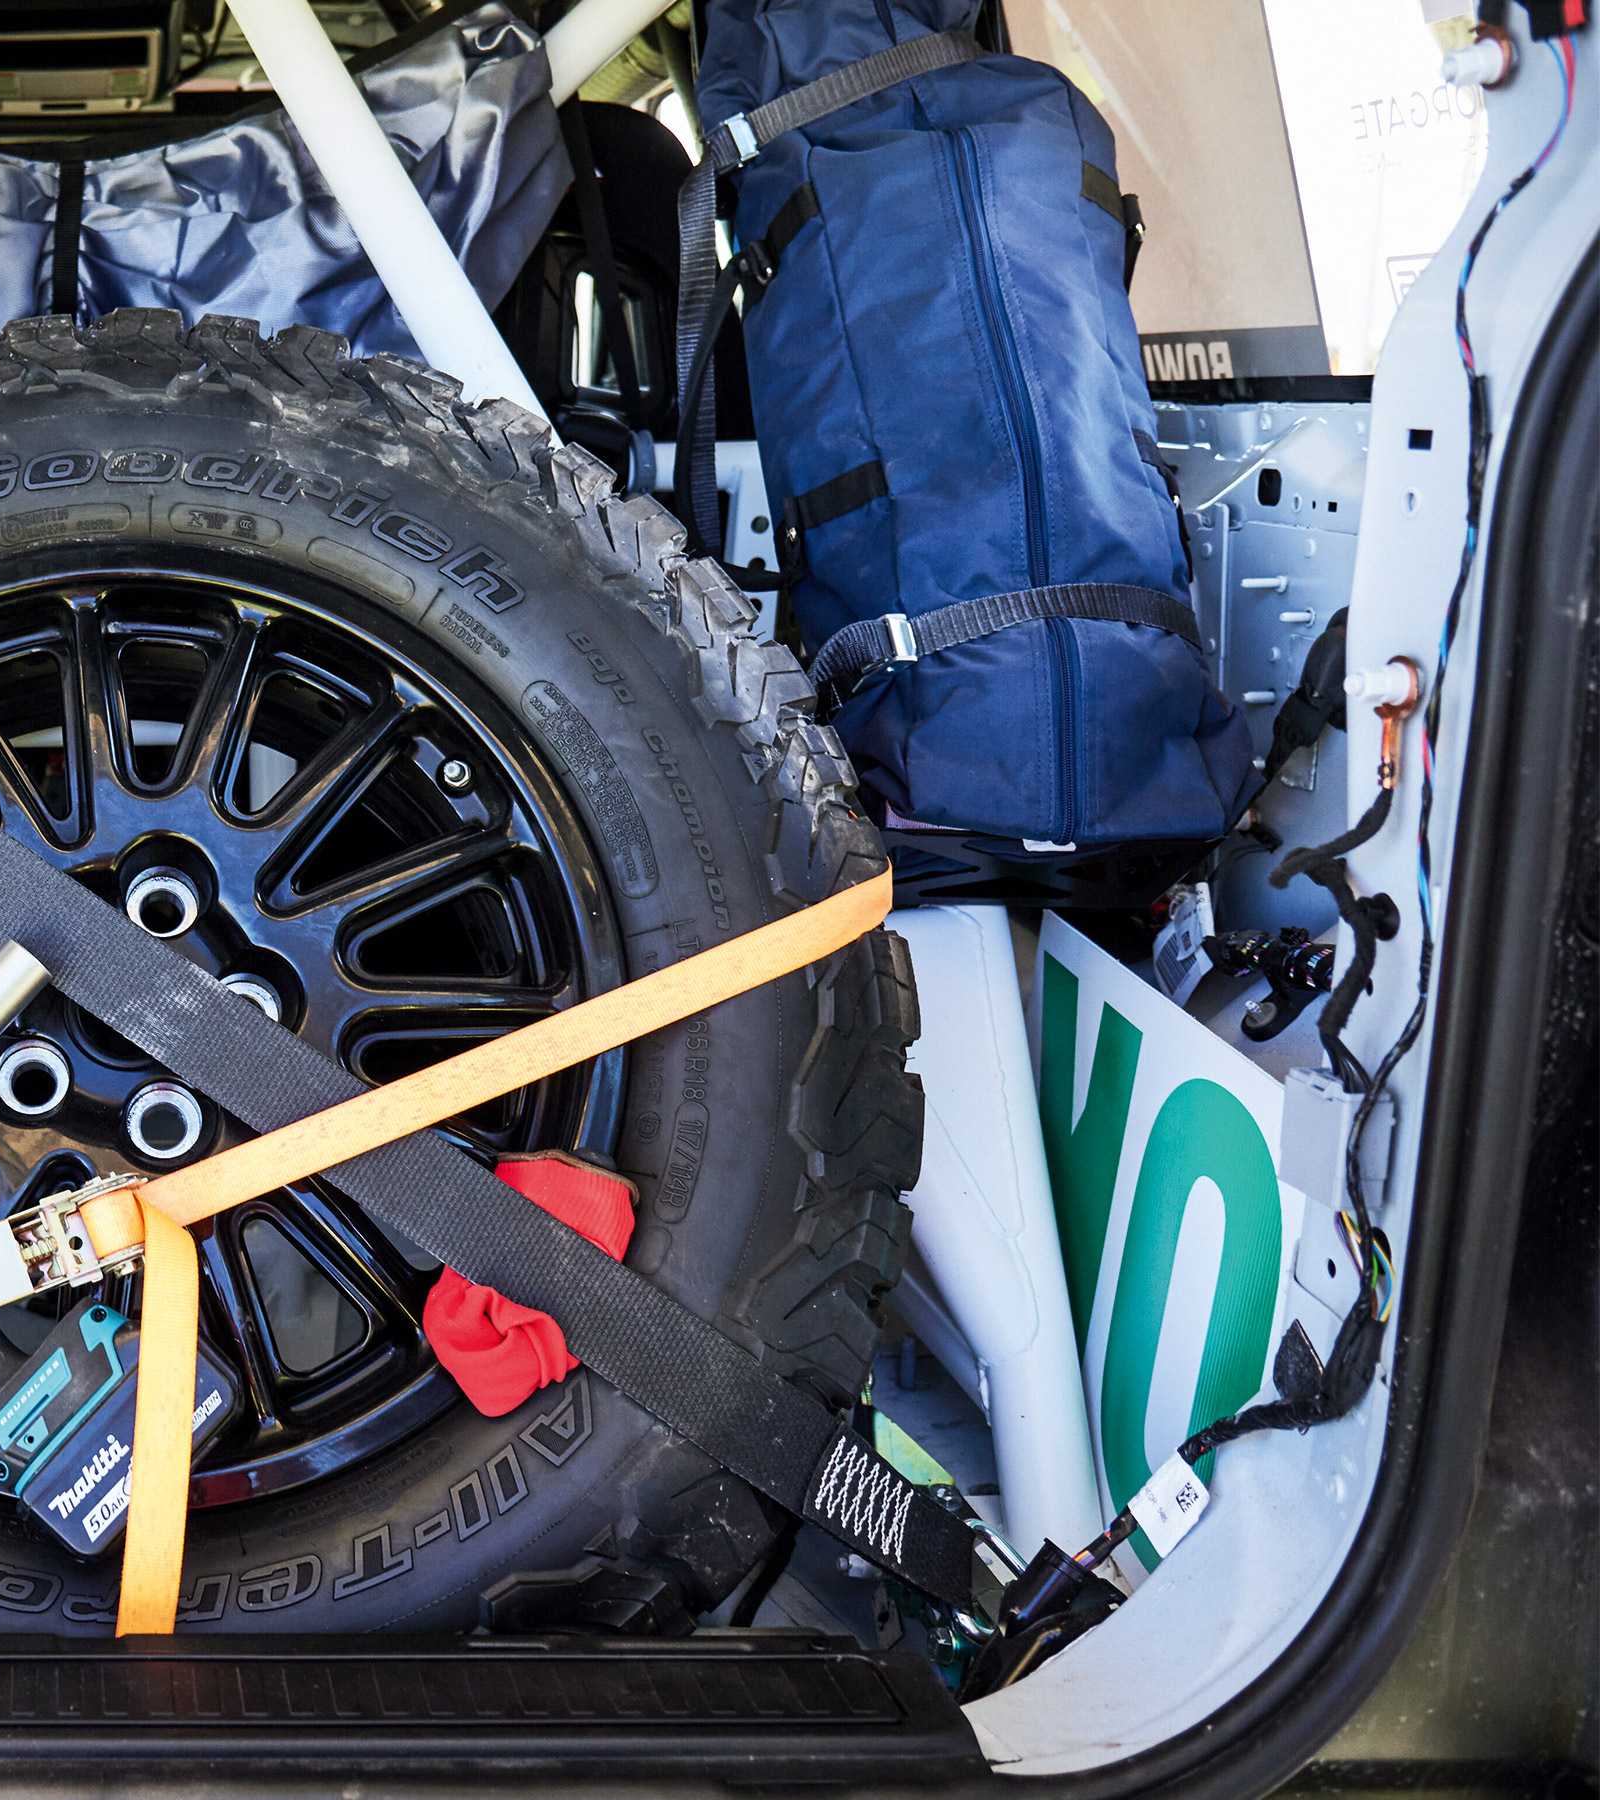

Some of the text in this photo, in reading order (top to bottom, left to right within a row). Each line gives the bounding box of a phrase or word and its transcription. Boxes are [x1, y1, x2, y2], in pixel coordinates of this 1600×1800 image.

[439, 616, 482, 655] RADIAL
[450, 603, 510, 658] TUBELESS
[529, 696, 551, 719] MAX
[548, 715, 574, 747] LOAD
[571, 744, 592, 776] DUAL
[543, 683, 565, 709] MAX
[565, 705, 589, 735] LOAD
[586, 731, 615, 770] SINGLE
[537, 719, 552, 732] AT
[604, 825, 621, 856] COLD
[555, 709, 570, 725] AT
[620, 814, 638, 847] COLD
[566, 628, 732, 932] Baja Champion
[0, 1359, 61, 1427] BRUSHLESS
